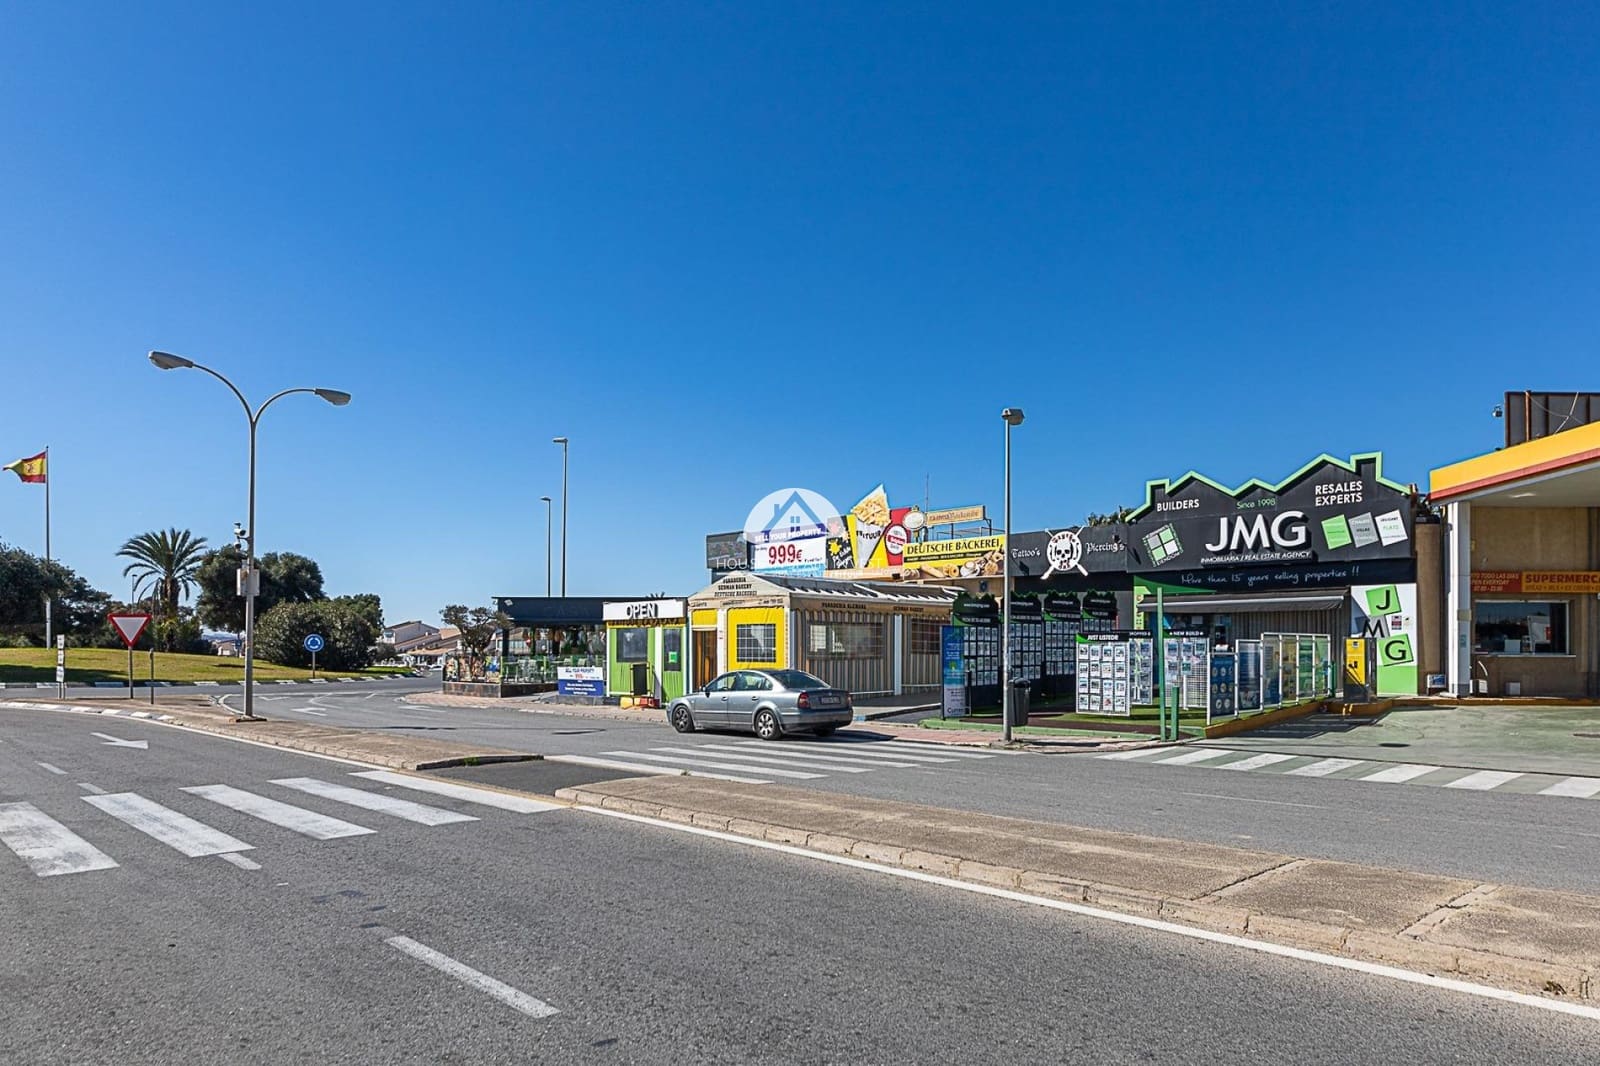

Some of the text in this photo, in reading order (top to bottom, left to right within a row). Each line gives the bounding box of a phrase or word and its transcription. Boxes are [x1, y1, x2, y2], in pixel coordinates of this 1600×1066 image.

[1315, 481, 1363, 496] RESALES
[1156, 499, 1200, 512] BUILDERS
[1236, 497, 1276, 510] Since 1998
[1315, 493, 1363, 507] EXPERTS
[1205, 511, 1308, 554] JMG
[768, 544, 803, 565] 999€
[906, 542, 953, 556] DEUTSCHE
[1245, 553, 1260, 561] REAL
[1260, 551, 1281, 561] ESTATE
[1208, 571, 1227, 583] than
[1232, 570, 1242, 582] 15
[1248, 572, 1269, 586] years
[1275, 568, 1299, 584] selling
[1305, 566, 1348, 582] properties
[1525, 573, 1600, 584] SUPERMERC
[1376, 589, 1391, 610] J
[626, 603, 659, 619] OPEN
[1362, 619, 1386, 639] M
[1385, 640, 1407, 661] G
